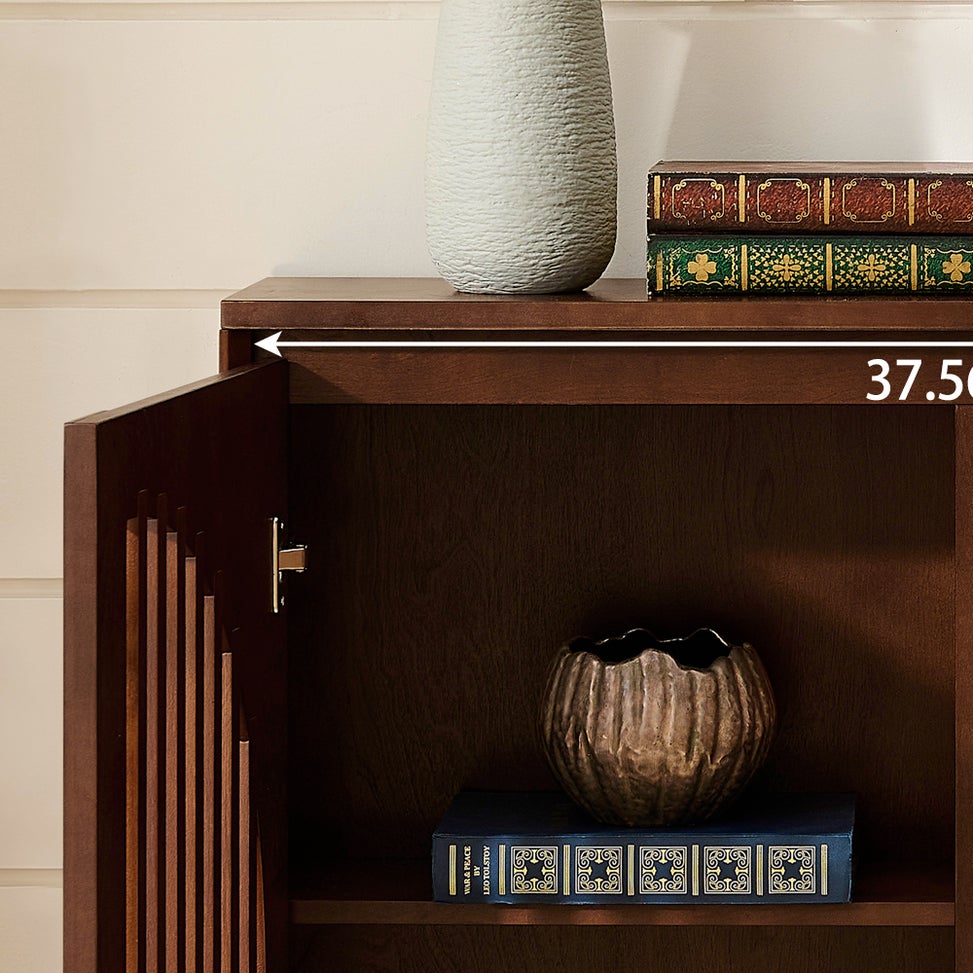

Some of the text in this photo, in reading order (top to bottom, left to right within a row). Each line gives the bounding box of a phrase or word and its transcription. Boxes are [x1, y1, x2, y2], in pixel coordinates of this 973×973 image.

[463, 845, 471, 870] PEACE
[473, 865, 480, 876] BY
[463, 878, 471, 895] WAR
